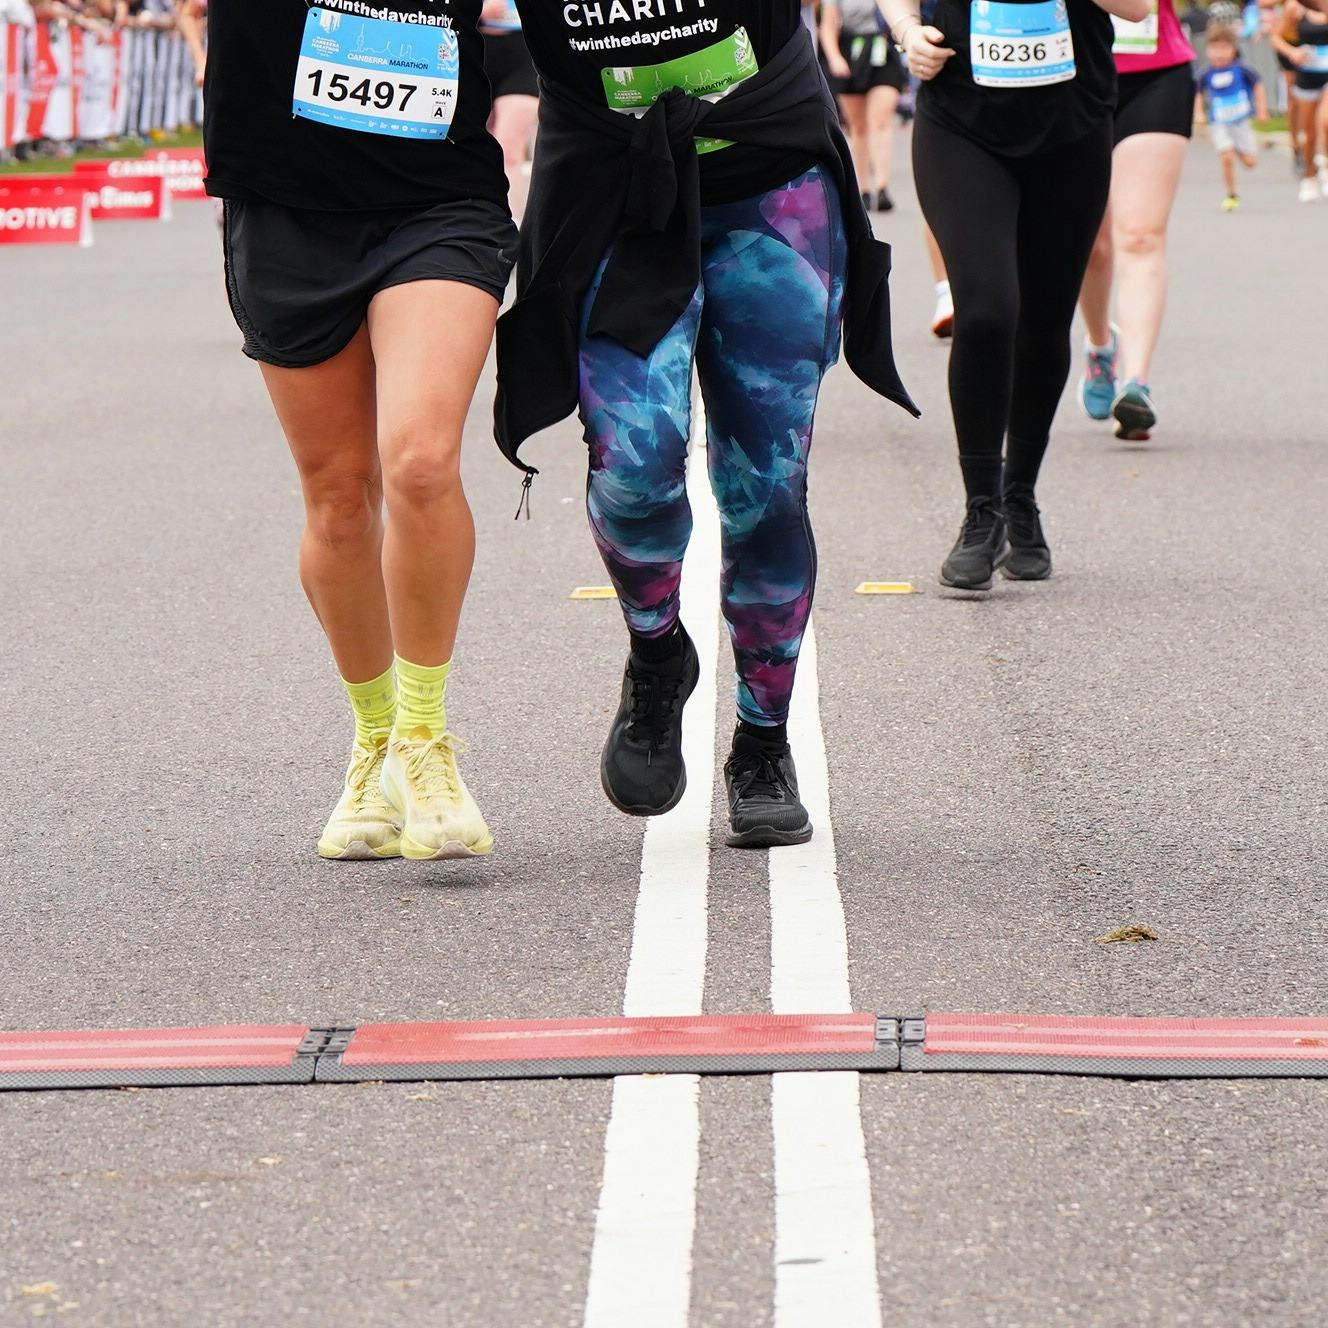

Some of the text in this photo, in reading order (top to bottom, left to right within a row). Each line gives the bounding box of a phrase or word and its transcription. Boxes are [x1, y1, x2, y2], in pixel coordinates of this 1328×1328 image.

[569, 18, 719, 51] #winthedaycharity
[977, 42, 1047, 62] 16236
[347, 53, 429, 70] CANBERRA MARATHON
[308, 69, 418, 112] 15497
[431, 87, 453, 97] 5.4K
[693, 76, 734, 94] MARATHON
[434, 107, 443, 118] A
